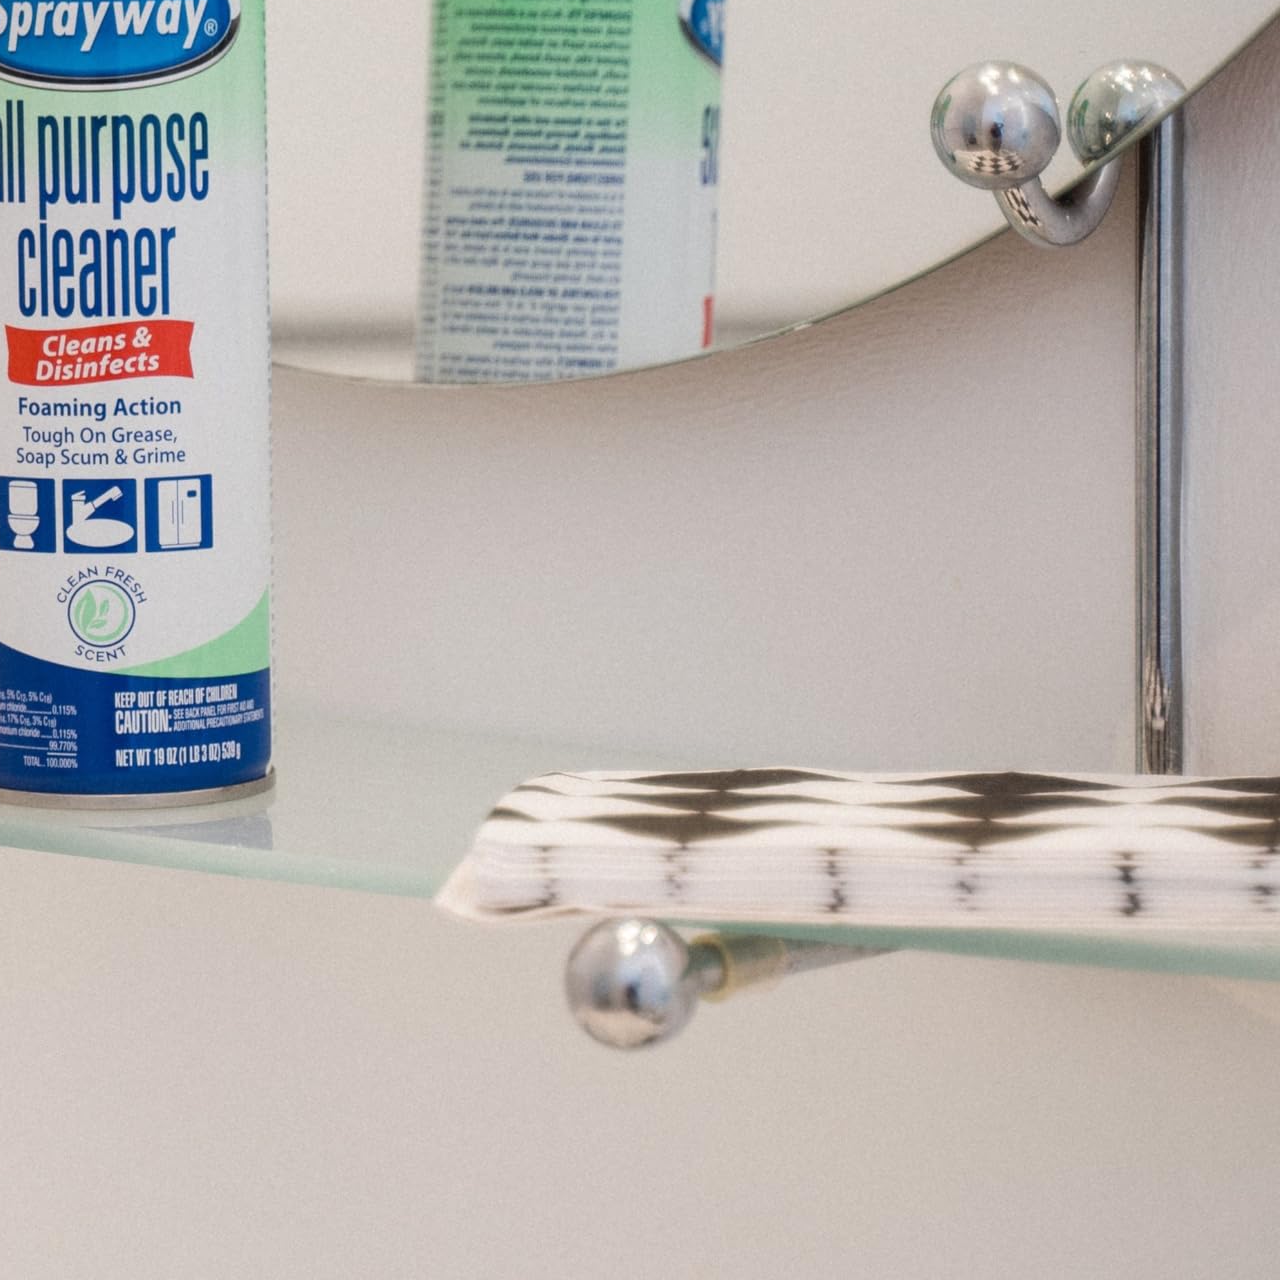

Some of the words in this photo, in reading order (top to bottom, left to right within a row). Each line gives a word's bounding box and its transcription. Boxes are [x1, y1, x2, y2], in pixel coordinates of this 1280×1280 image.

[37, 111, 209, 220] purpose
[18, 223, 176, 318] cleaner
[43, 332, 126, 357] Cleans
[132, 326, 152, 348] &
[36, 352, 160, 381] Disinfects
[18, 397, 107, 421] Foaming
[113, 396, 181, 416] Action
[23, 426, 74, 447] Tough
[80, 427, 106, 443] On
[112, 427, 177, 444] Grease,
[16, 447, 55, 468] Soap
[61, 449, 109, 465] Scum
[115, 449, 127, 465] &
[133, 447, 186, 464] Grime
[57, 565, 98, 603] CLEAN
[105, 566, 147, 604] FRESH
[75, 645, 126, 662] SCENT
[115, 692, 136, 708] KEEP
[138, 691, 154, 708] OUT
[156, 690, 167, 707] OF
[168, 688, 193, 706] REACH
[195, 687, 205, 704] OF
[52, 704, 77, 716] 0.115%
[115, 708, 172, 734] CAUTION:
[173, 708, 185, 720] SEE
[49, 740, 78, 752] 99.770%
[52, 729, 78, 740] 0.115%
[115, 749, 133, 767] NET
[136, 748, 151, 767] WT
[154, 747, 165, 766] 19
[166, 746, 178, 766] OZ
[179, 745, 187, 766] (1
[189, 744, 200, 763] LB
[202, 744, 208, 762] 3
[208, 743, 221, 762] OZ)
